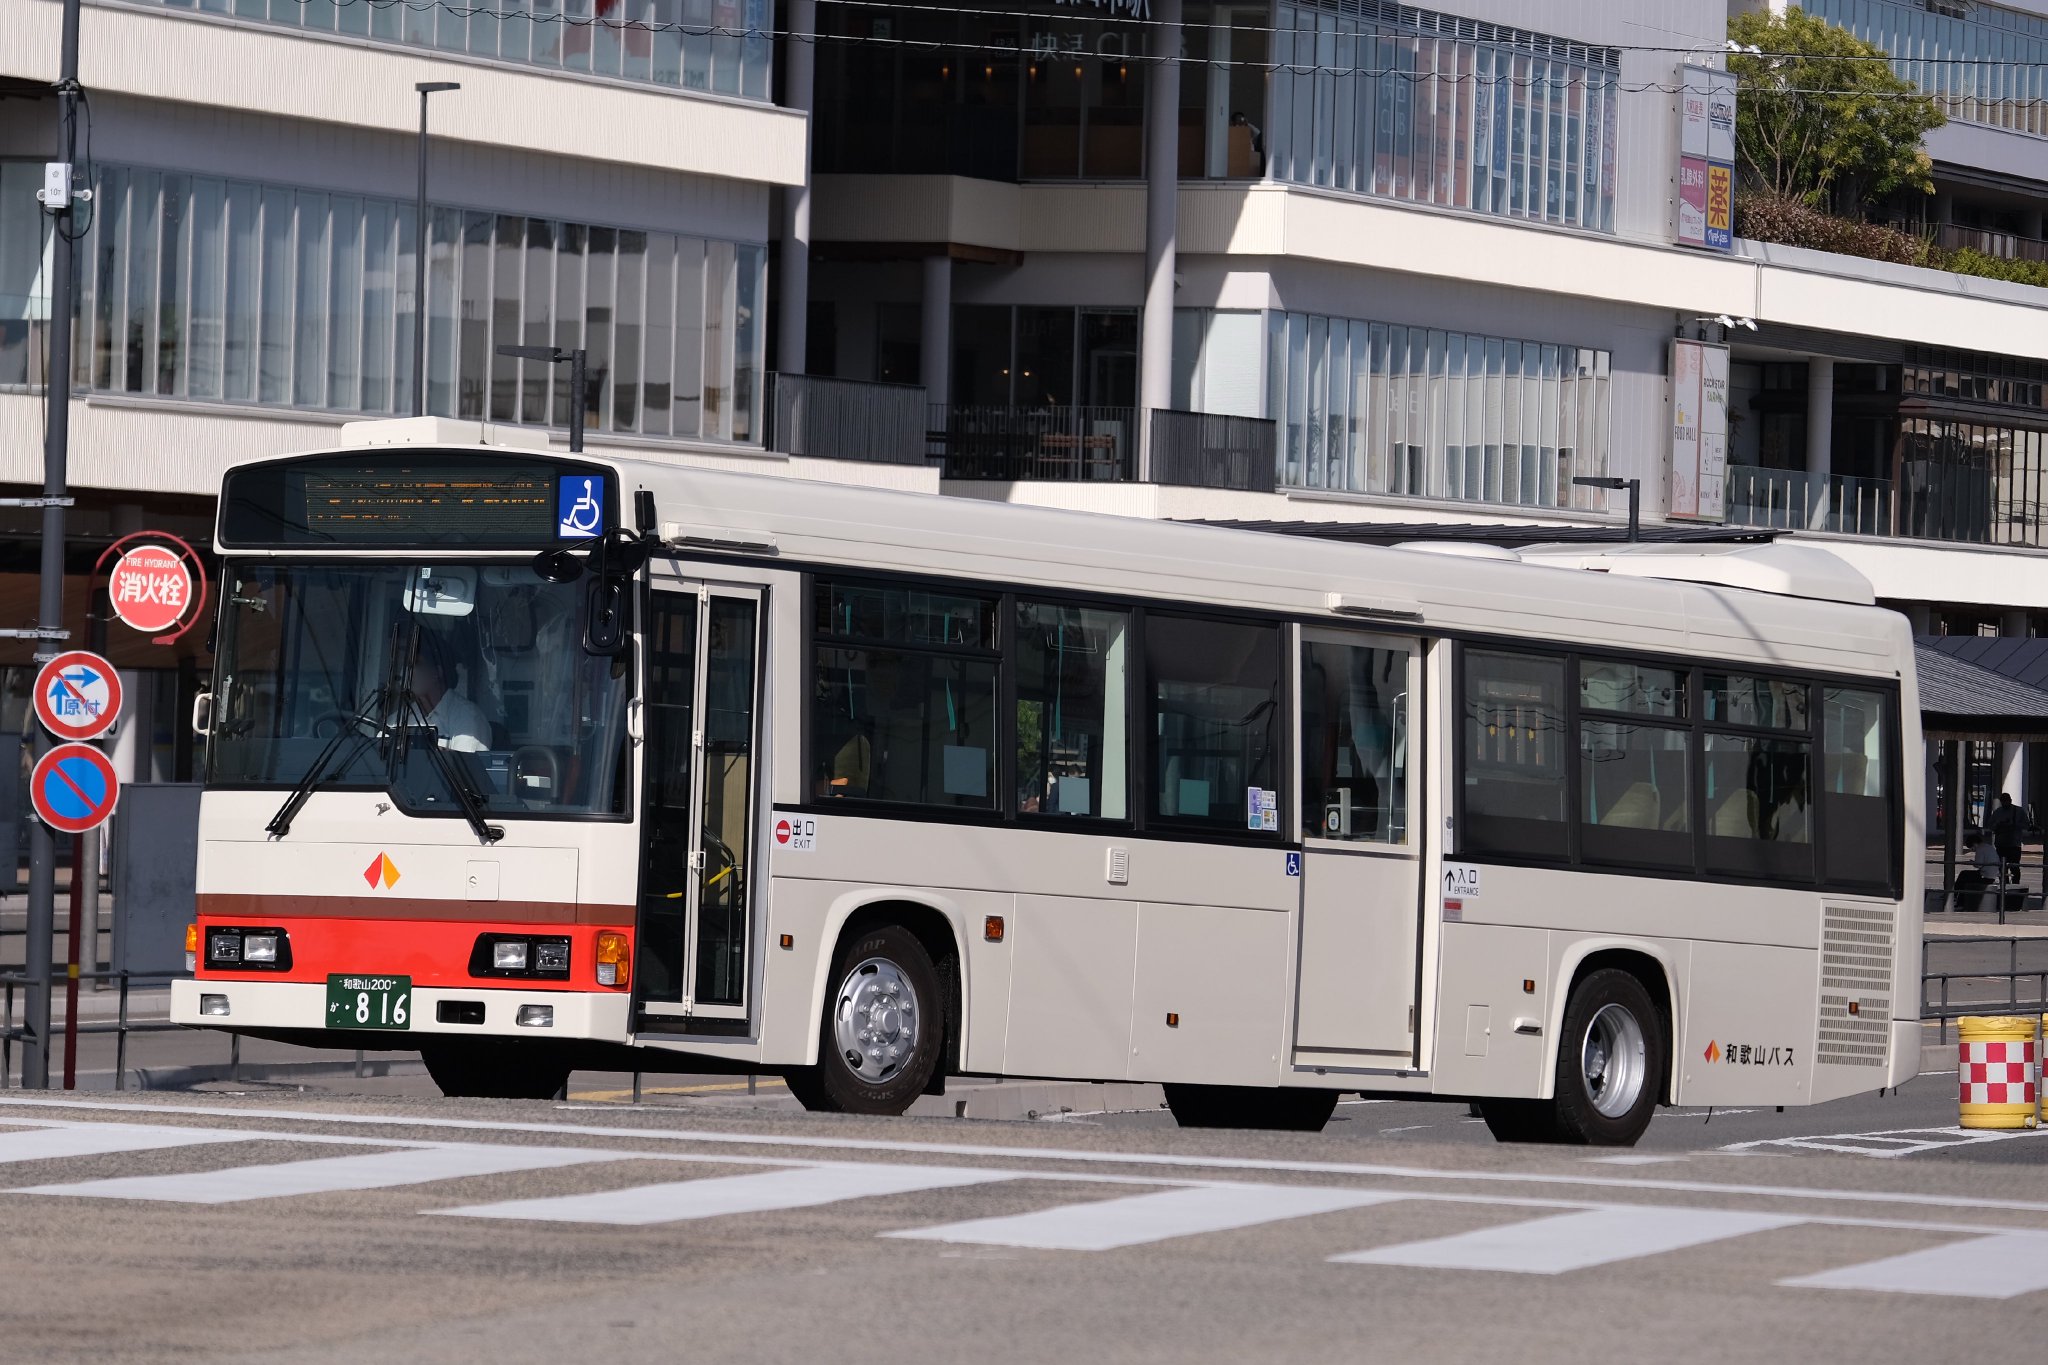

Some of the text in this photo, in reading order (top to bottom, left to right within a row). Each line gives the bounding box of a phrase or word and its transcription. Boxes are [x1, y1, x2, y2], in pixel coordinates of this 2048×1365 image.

[1709, 169, 1729, 227] 薬
[126, 557, 177, 569] FIRE HYDRANT
[118, 571, 184, 606] 消火栓
[64, 699, 101, 715] 原付
[792, 819, 814, 836] 出口
[793, 838, 811, 849] EXIT
[1457, 868, 1477, 884] 入口
[1454, 886, 1479, 896] ENTRANCE
[343, 978, 392, 991] 和歌山200
[1726, 1043, 1794, 1066] 和歌山バス
